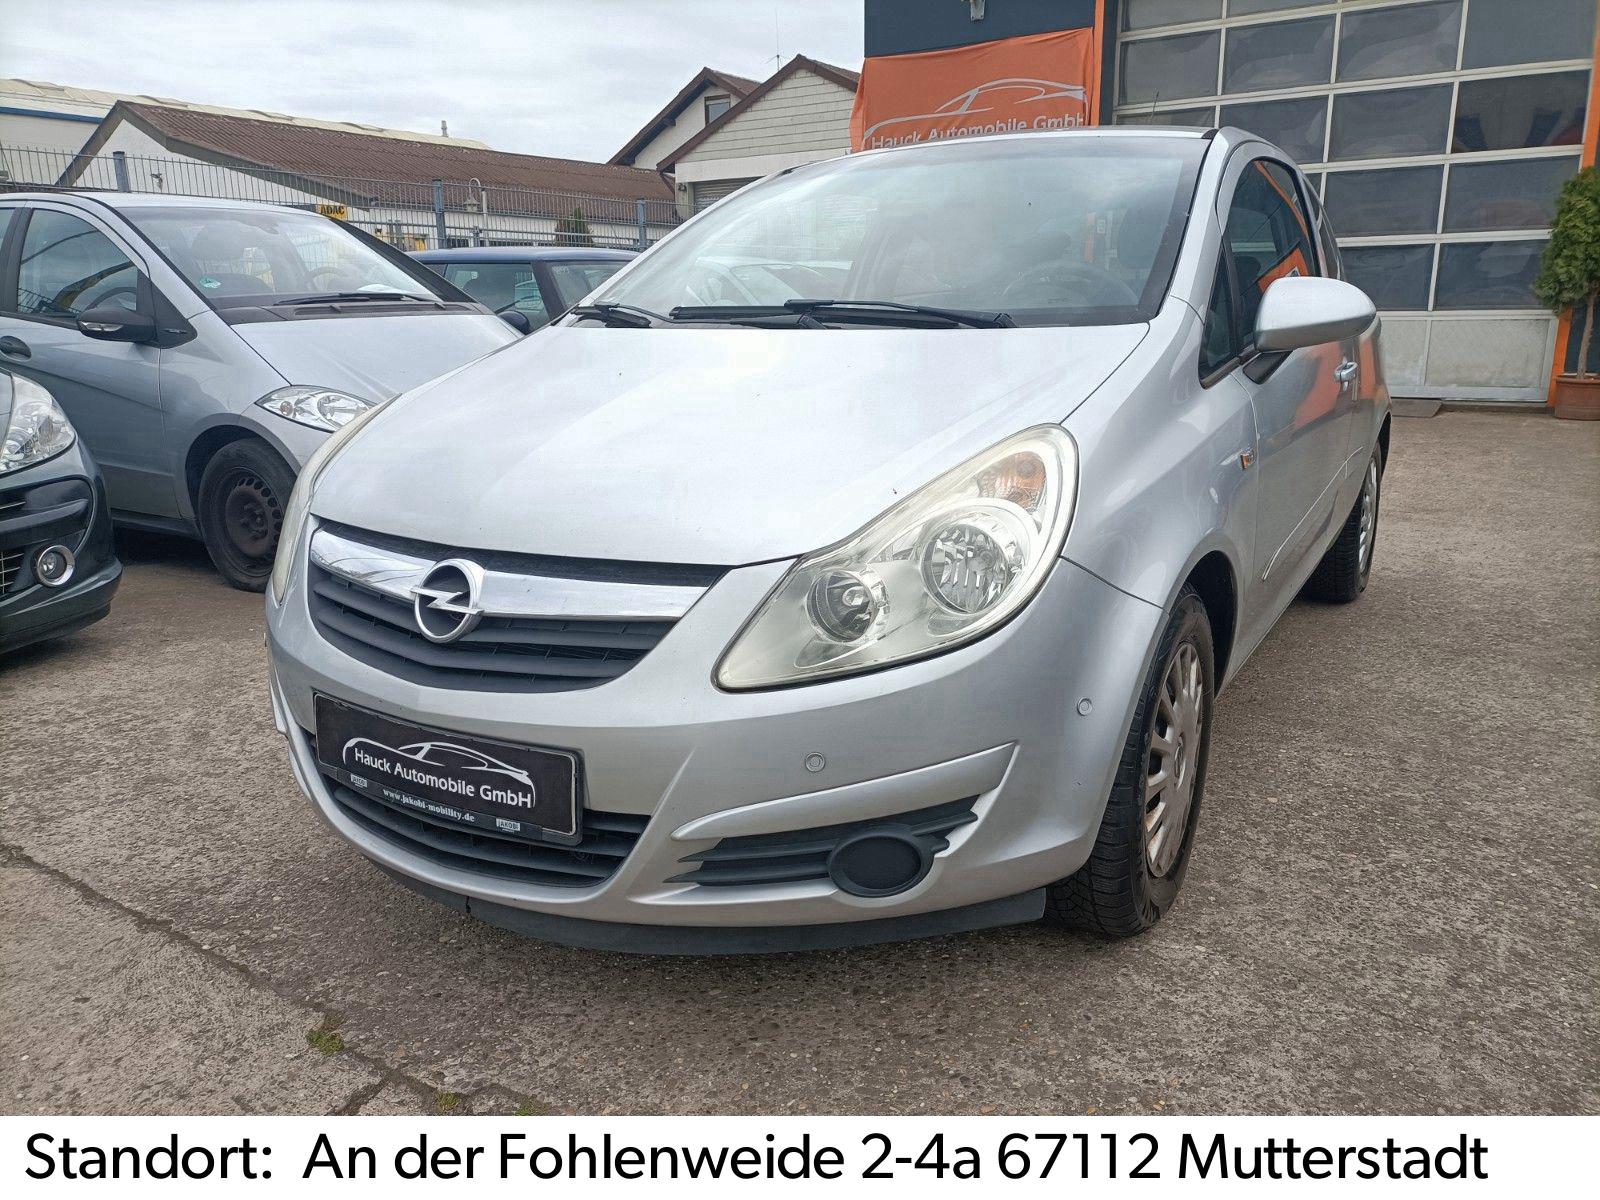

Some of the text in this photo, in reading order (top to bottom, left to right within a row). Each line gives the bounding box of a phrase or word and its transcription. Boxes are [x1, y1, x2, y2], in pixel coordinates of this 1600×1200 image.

[928, 117, 1027, 141] Automobile
[320, 205, 345, 215] ADAC
[354, 748, 532, 809] Hauck Automobile GmbH
[382, 788, 476, 823] www.jakobi-mobility.de
